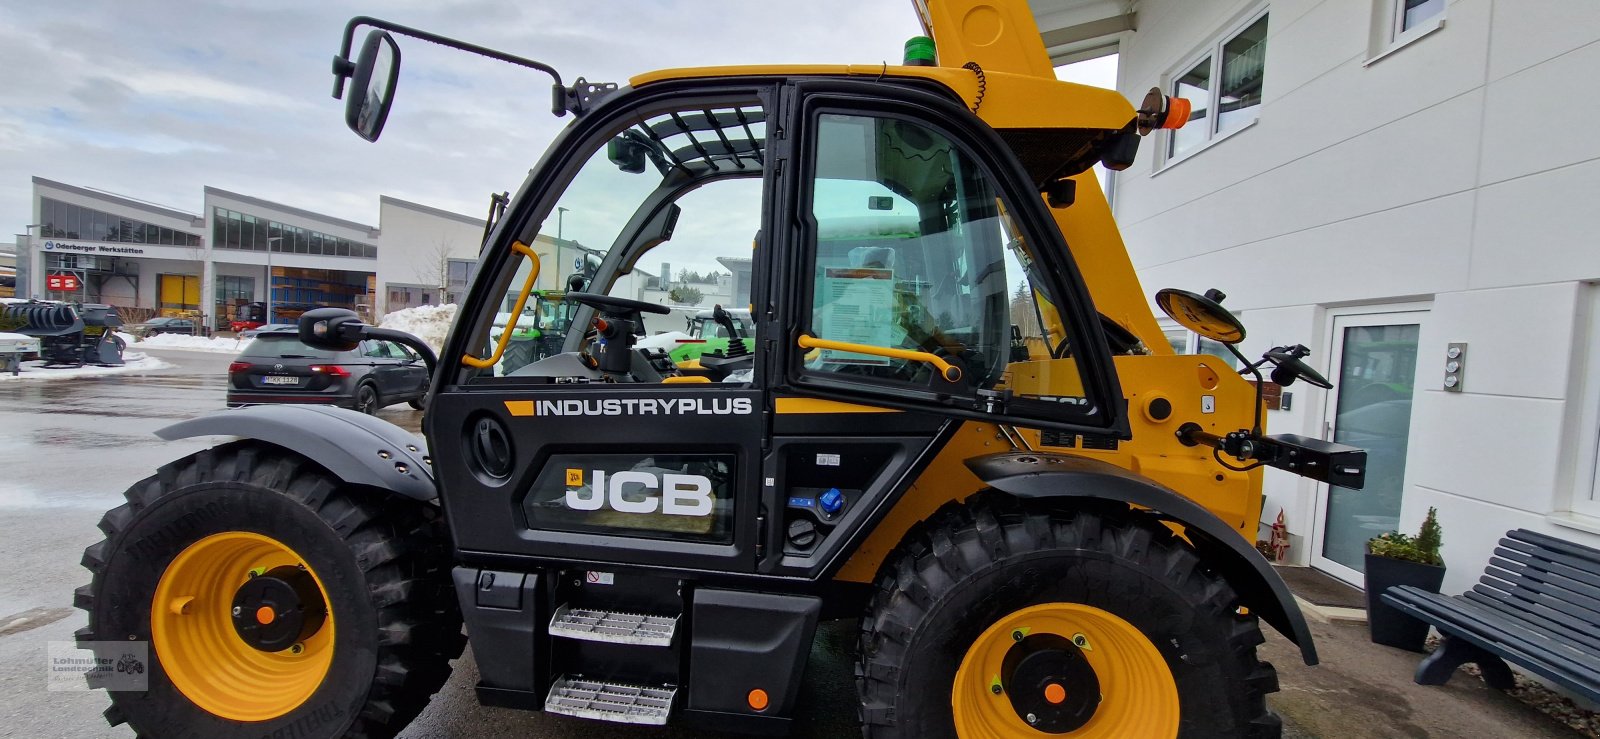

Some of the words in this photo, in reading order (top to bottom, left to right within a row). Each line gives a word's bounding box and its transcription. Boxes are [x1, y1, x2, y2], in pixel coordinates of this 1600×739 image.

[55, 242, 97, 253] Oderberger
[98, 245, 144, 255] Werkstätten
[536, 398, 753, 416] INDUSTRYPLUS
[565, 470, 713, 517] JCB
